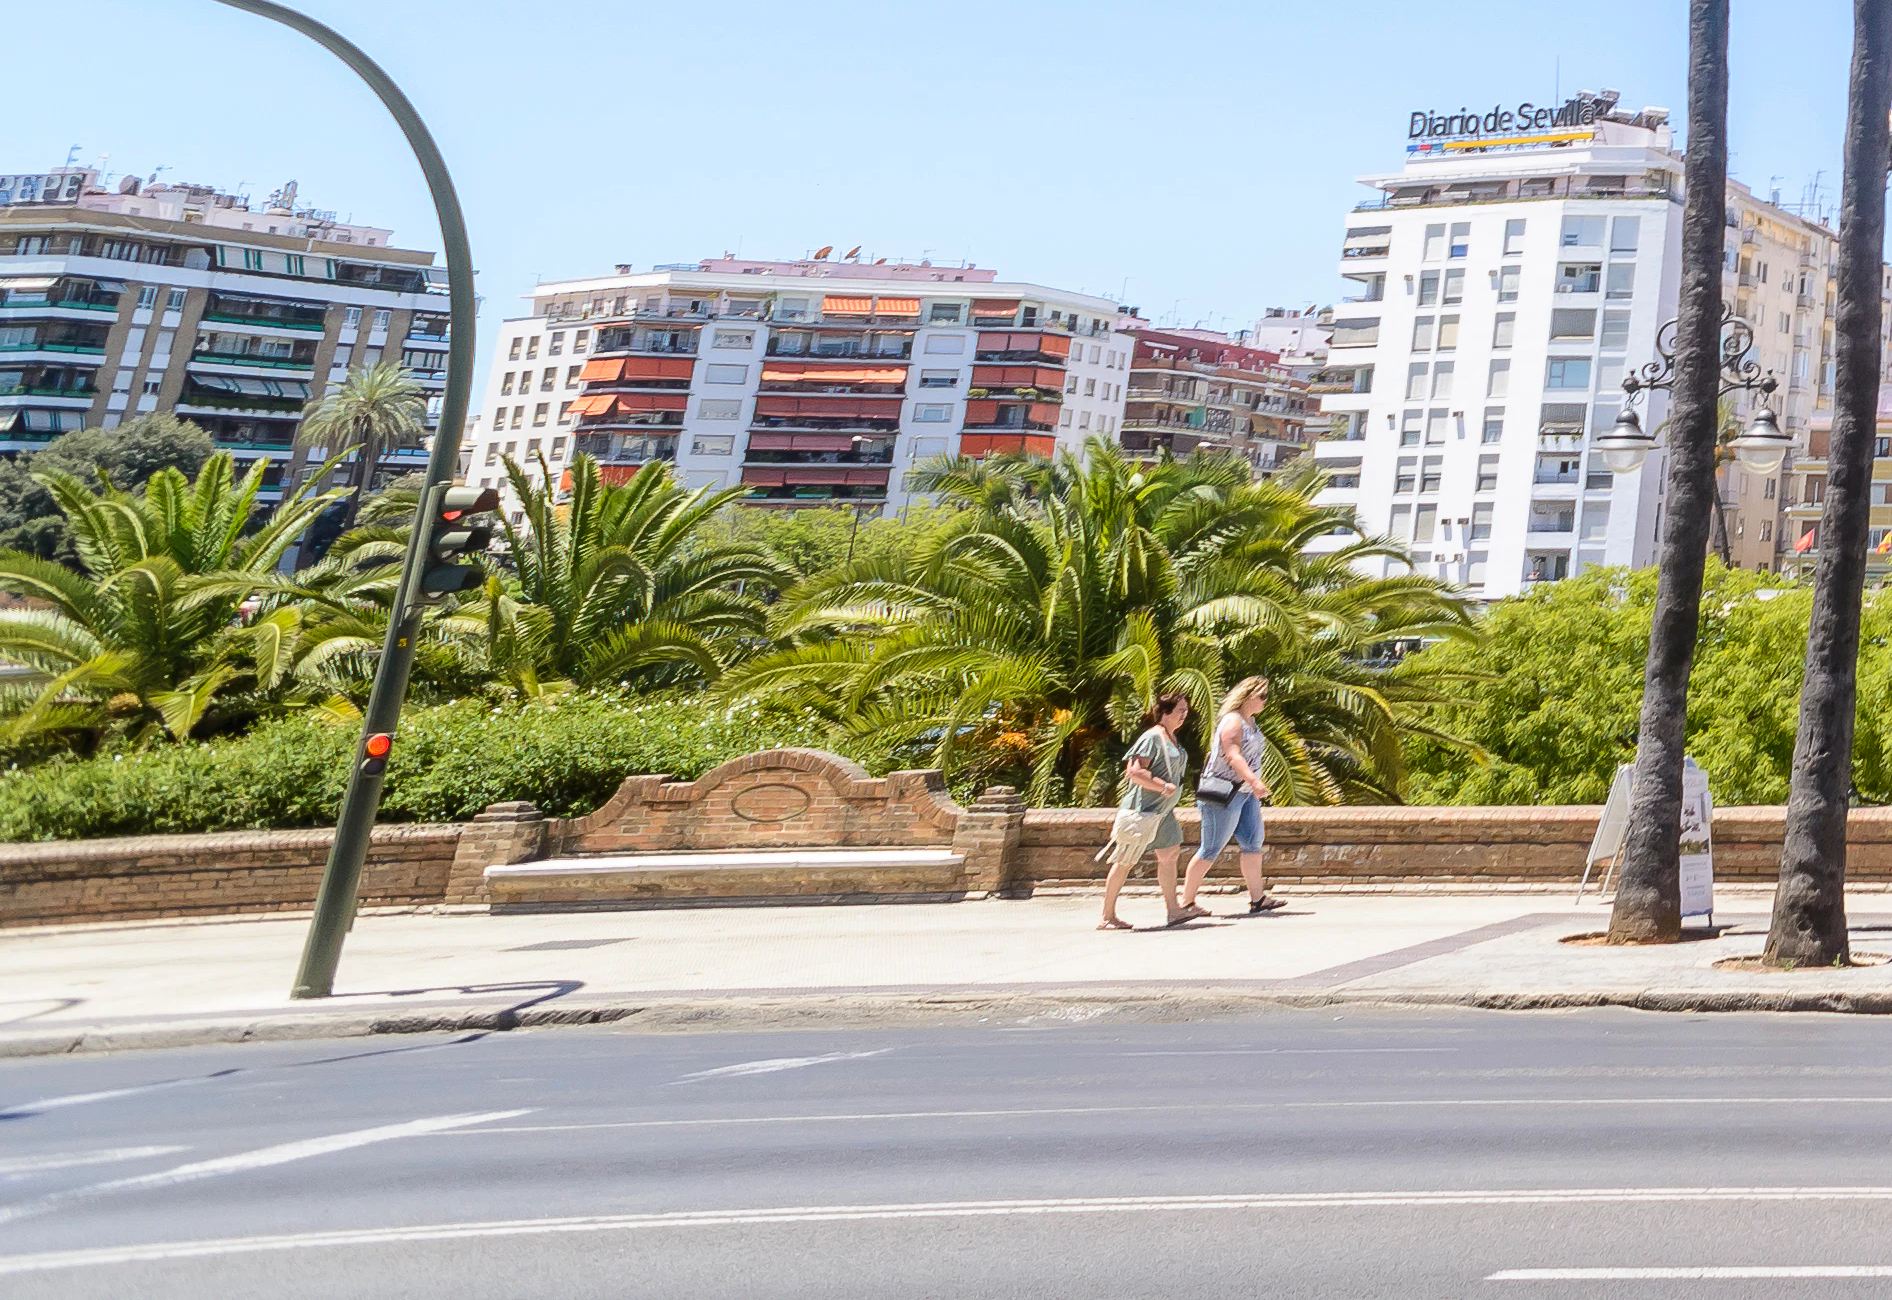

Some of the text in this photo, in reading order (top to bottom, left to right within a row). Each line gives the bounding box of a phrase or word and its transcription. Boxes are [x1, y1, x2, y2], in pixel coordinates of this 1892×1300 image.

[1408, 99, 1596, 139] Diario de Sevilla
